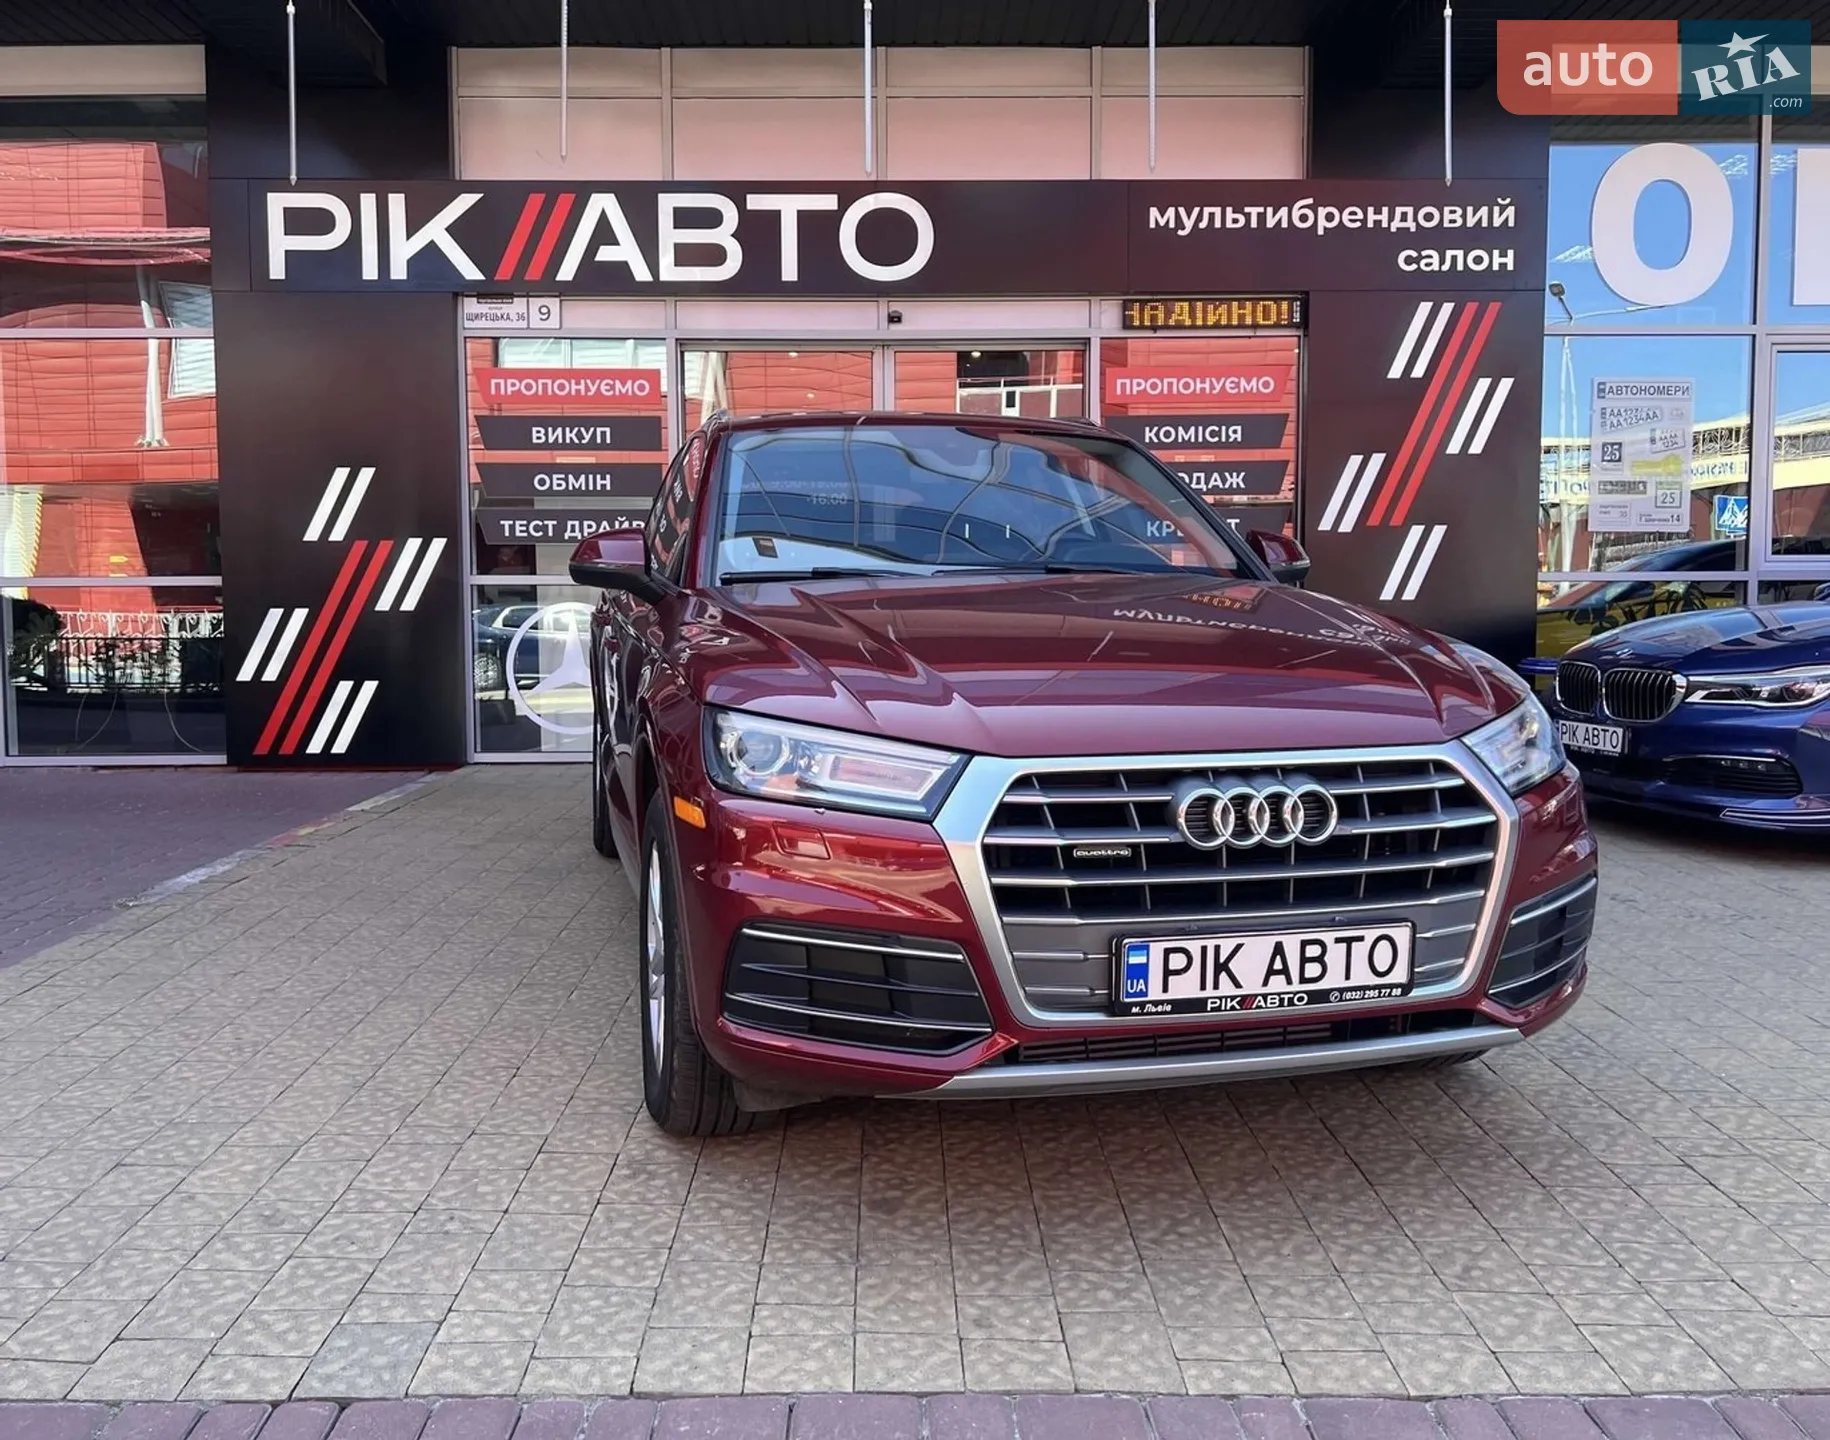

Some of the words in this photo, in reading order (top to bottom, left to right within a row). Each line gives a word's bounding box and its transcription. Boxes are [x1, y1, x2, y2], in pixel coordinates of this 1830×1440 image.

[1148, 196, 1516, 236] мультибрендовий
[1396, 244, 1516, 272] салон
[515, 312, 526, 322] 36
[538, 304, 551, 322] 9
[489, 378, 651, 396] ПРОПОНУЄМО
[1115, 376, 1276, 396] ПРОПОНУЄМО
[1607, 385, 1691, 397] АВТОНОМЕРИ
[531, 426, 612, 444] ВИКУП
[1144, 425, 1243, 444] КОМІСІЯ
[1603, 444, 1619, 461] 25
[533, 474, 612, 491] ОБМІН
[1660, 491, 1676, 505] 25
[499, 520, 558, 537] ТЕСТ
[1560, 722, 1580, 744] РІК
[1582, 726, 1620, 749] АВТО
[1076, 848, 1130, 857] quattro
[1161, 942, 1246, 994] РІК
[1261, 933, 1400, 988] АВТО
[1127, 979, 1147, 993] UA
